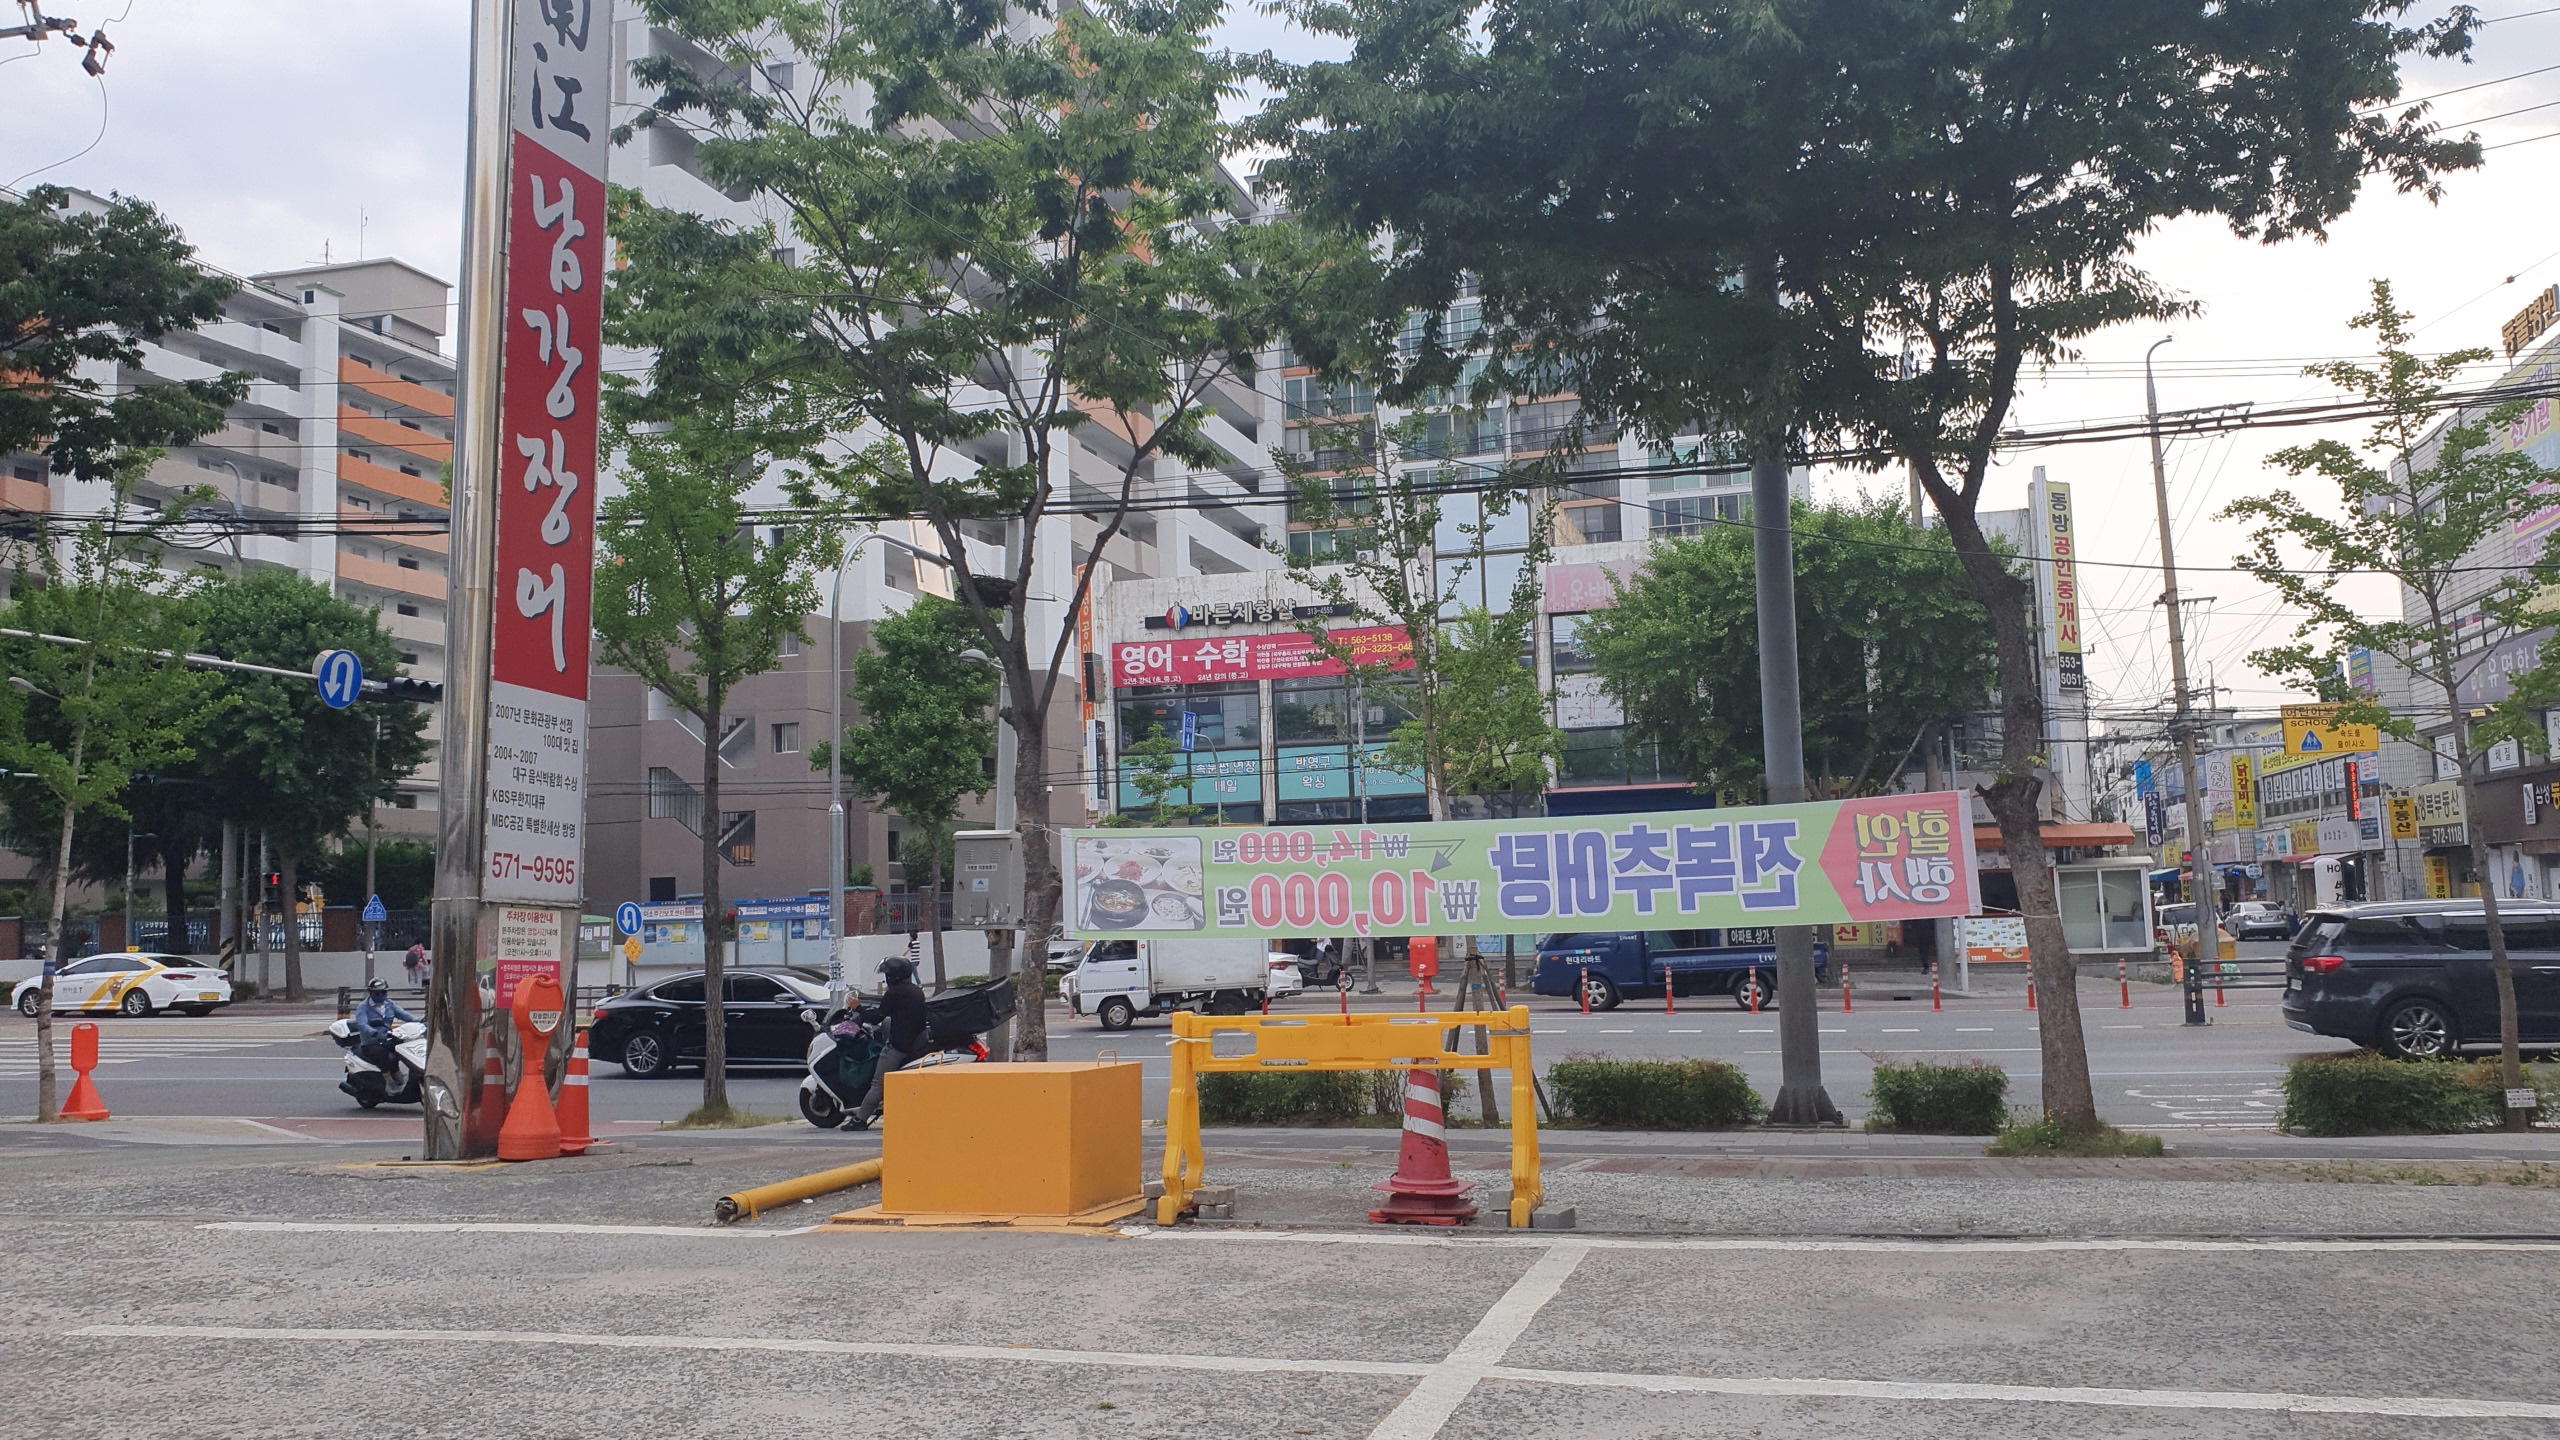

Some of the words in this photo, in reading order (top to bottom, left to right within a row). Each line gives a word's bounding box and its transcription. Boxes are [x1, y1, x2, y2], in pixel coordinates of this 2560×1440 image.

[516, 174, 586, 673] 남강장어
[1192, 598, 1296, 626] 바른체형샵
[1351, 633, 1393, 644] 563-5138
[1121, 644, 1172, 675] 영어
[1194, 640, 1249, 670] 수학
[1198, 673, 1211, 681] 24년
[1214, 672, 1226, 680] 강의
[2061, 672, 2082, 686] 5051
[496, 704, 521, 723] 2007년
[523, 709, 558, 730] 문화관광부
[559, 718, 573, 734] 선정
[543, 734, 562, 751] 100대
[1233, 760, 1255, 774] 연장
[1295, 755, 1331, 770] 반영구
[512, 767, 527, 783] 대구
[528, 769, 563, 790] 음식박람회
[564, 775, 578, 792] 수상
[1302, 775, 1326, 789] 왁싱
[2236, 763, 2249, 803] 닭갈비
[491, 813, 524, 832] MBC공감
[562, 823, 576, 839] 방영
[2393, 799, 2411, 833] 부동산
[491, 852, 575, 885] 571-9595
[506, 911, 526, 922] 주차장
[527, 911, 553, 923] 이용안내
[1565, 955, 1602, 965] 현대리바트
